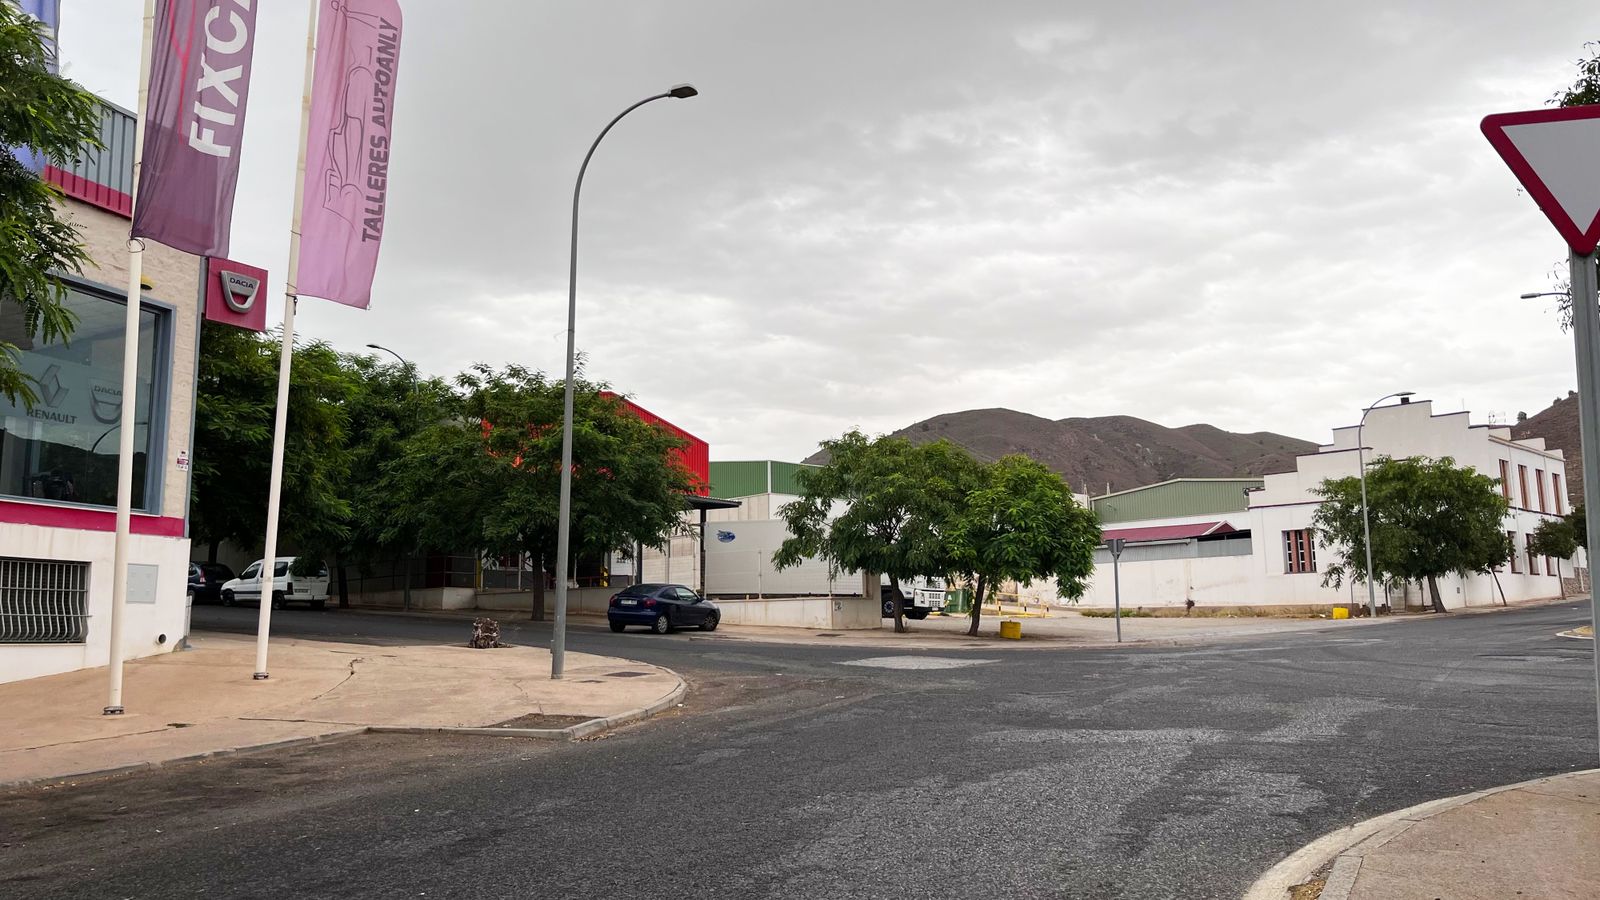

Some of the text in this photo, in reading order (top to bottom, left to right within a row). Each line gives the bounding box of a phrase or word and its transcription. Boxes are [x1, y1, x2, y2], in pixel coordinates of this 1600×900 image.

[362, 17, 398, 242] TALLERES AUTOANLY
[230, 277, 254, 289] DACIA
[27, 409, 77, 424] RENAULT
